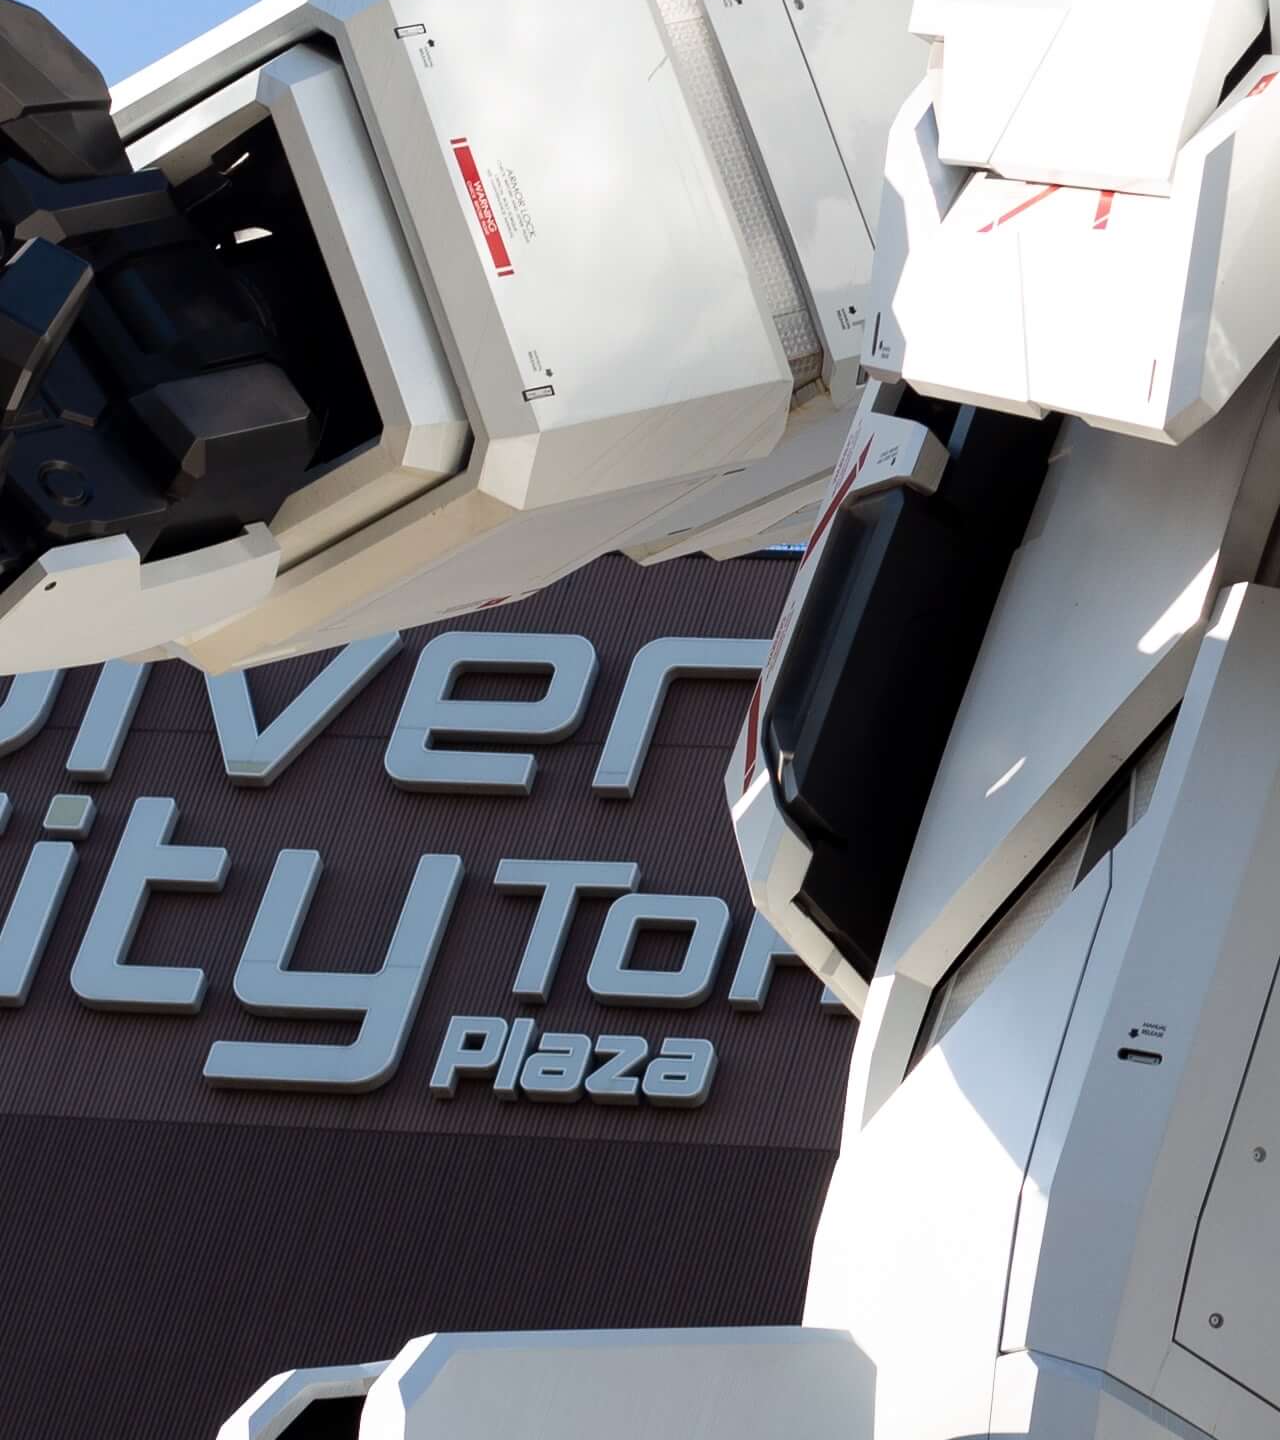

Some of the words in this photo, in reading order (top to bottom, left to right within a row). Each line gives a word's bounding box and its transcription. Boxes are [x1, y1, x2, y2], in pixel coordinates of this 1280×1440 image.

[473, 180, 497, 232] WARNING
[0, 631, 770, 798] iver
[0, 793, 464, 1093] ity
[429, 1016, 719, 1107] Plaza
